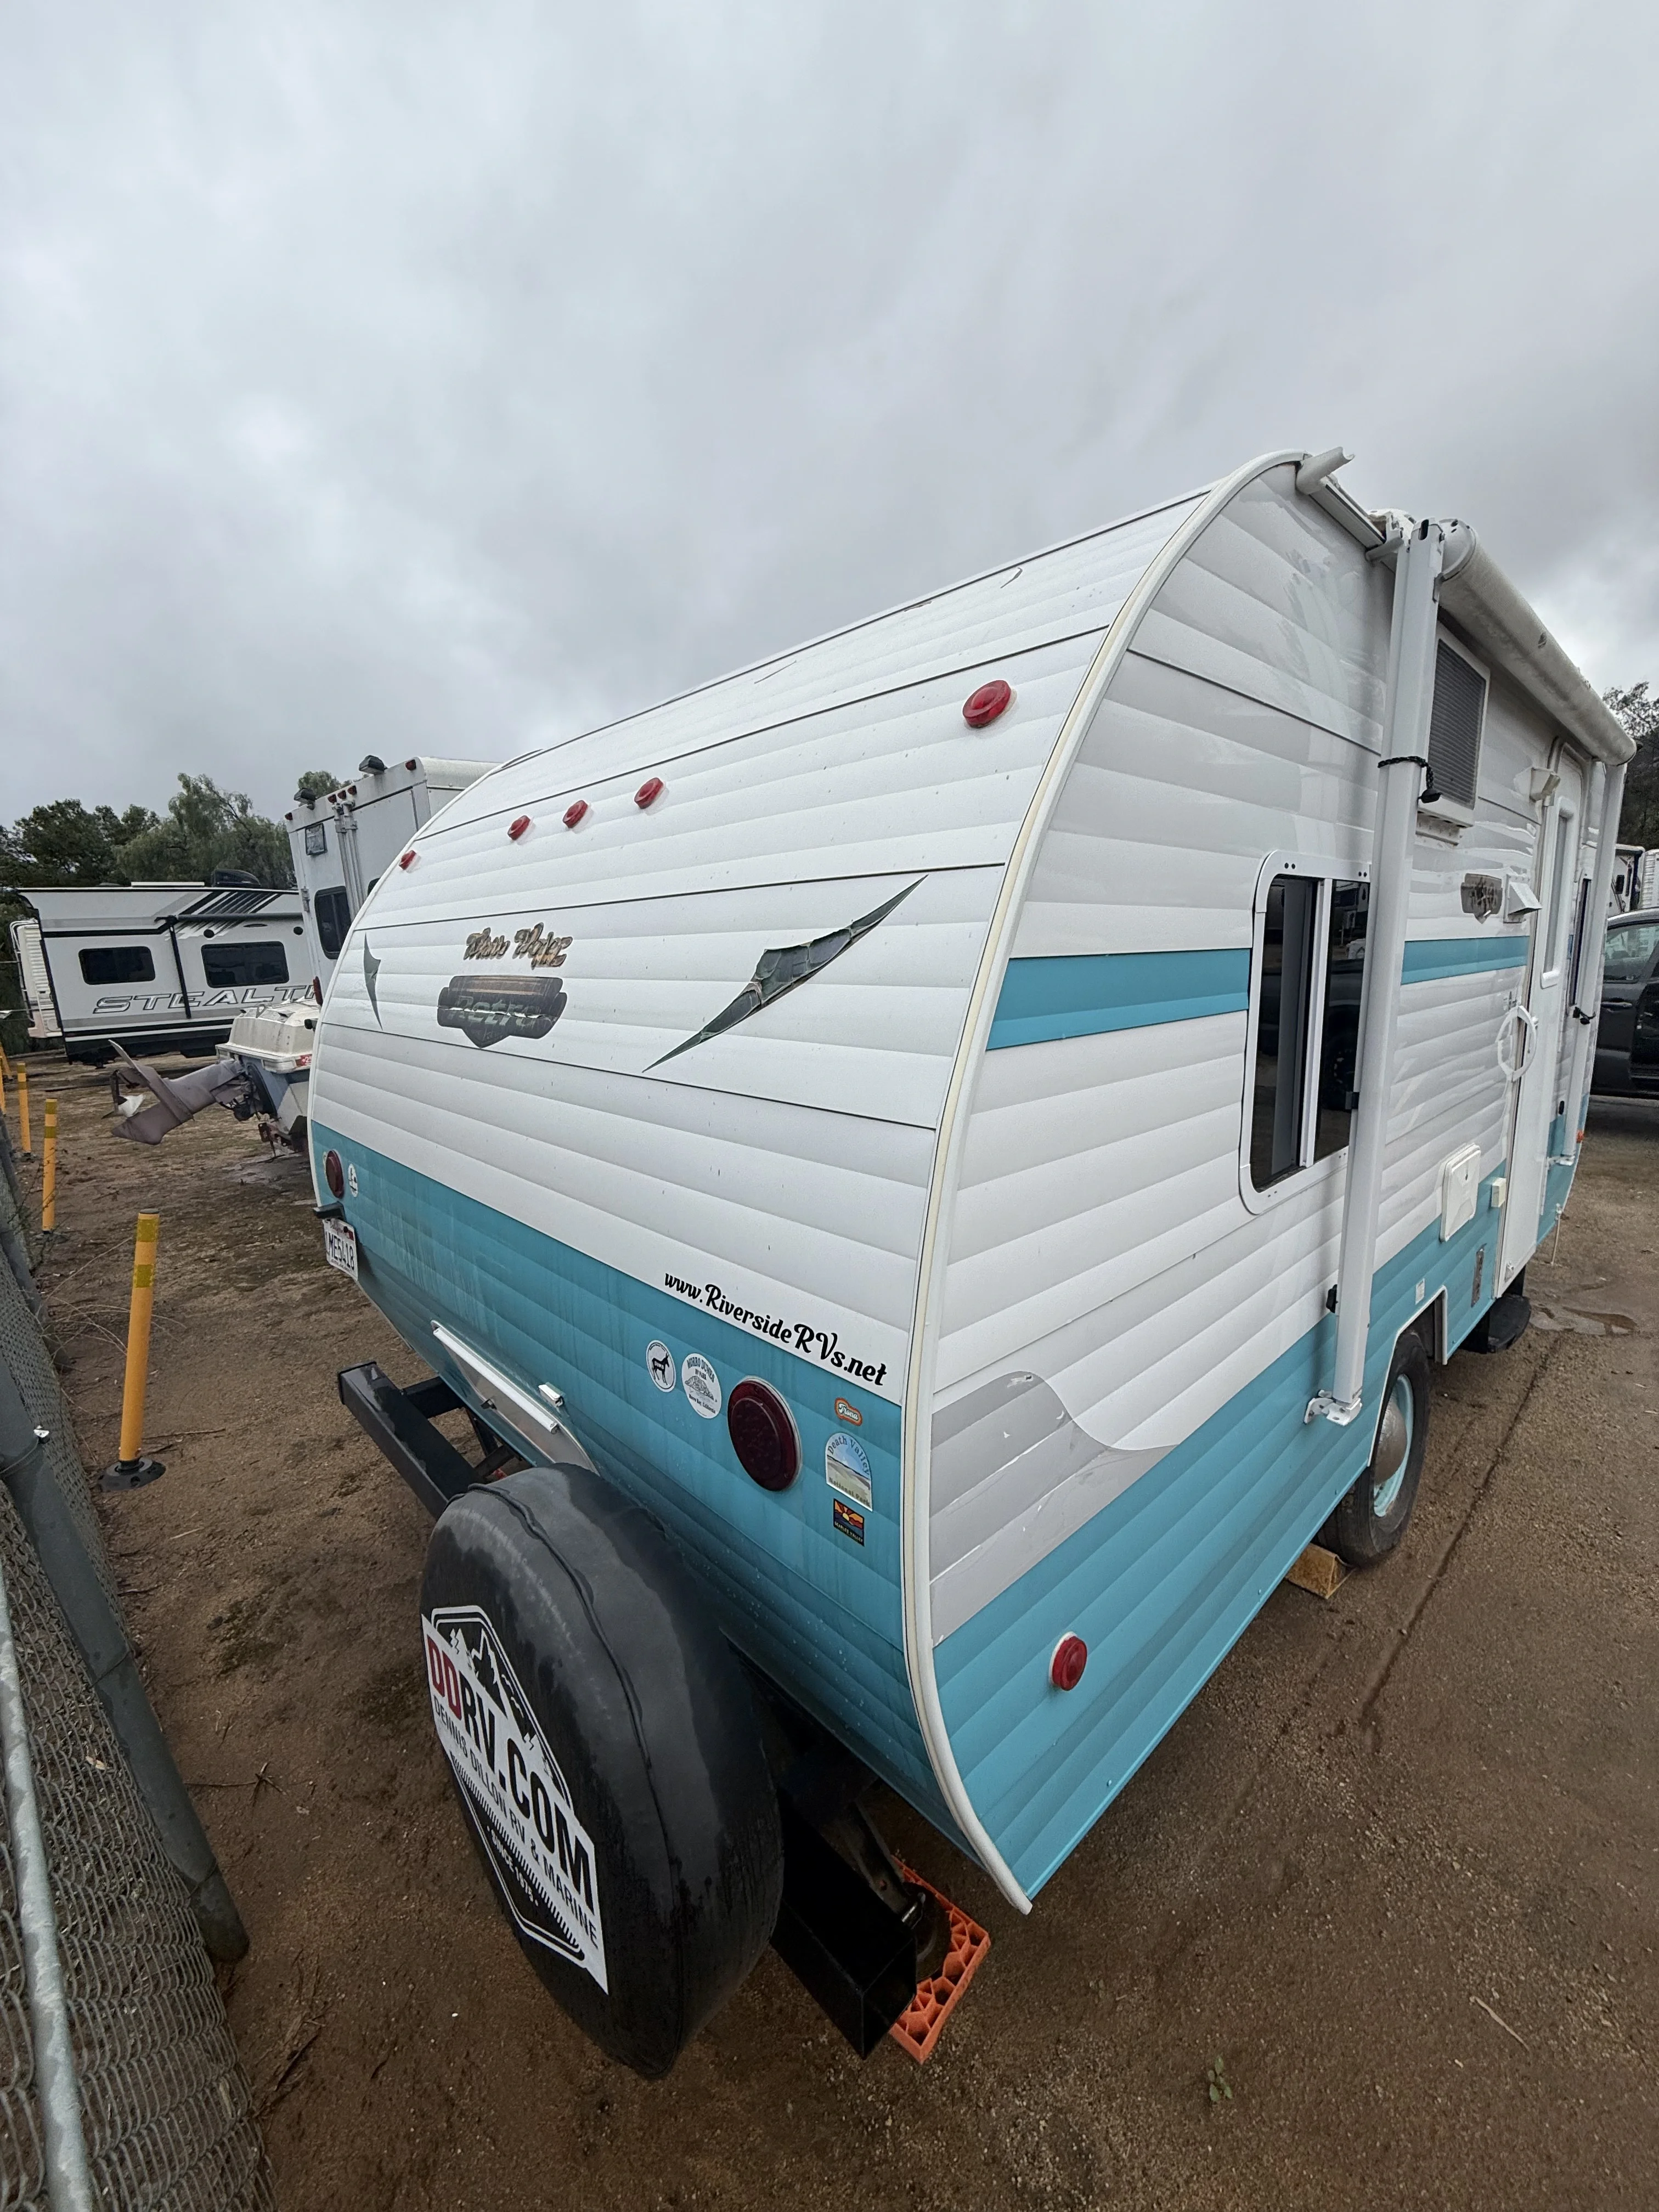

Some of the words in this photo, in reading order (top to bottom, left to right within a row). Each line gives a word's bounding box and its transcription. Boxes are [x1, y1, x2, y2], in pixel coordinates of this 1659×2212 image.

[93, 985, 316, 1014] STEALT
[664, 1272, 887, 1386] www.RiversideRVs.net
[701, 1359, 715, 1383] DUNES
[838, 1403, 859, 1420] Trona
[827, 1435, 848, 1455] Death
[850, 1438, 870, 1475] Valley
[829, 1477, 854, 1497] National
[855, 1493, 871, 1508] Park
[427, 1633, 595, 1916] DDRV.COM
[433, 1694, 468, 1758] DENNIS
[470, 1748, 507, 1819] DILLON
[509, 1808, 525, 1844] RV
[531, 1838, 540, 1866] &
[543, 1854, 599, 1950] MARINE
